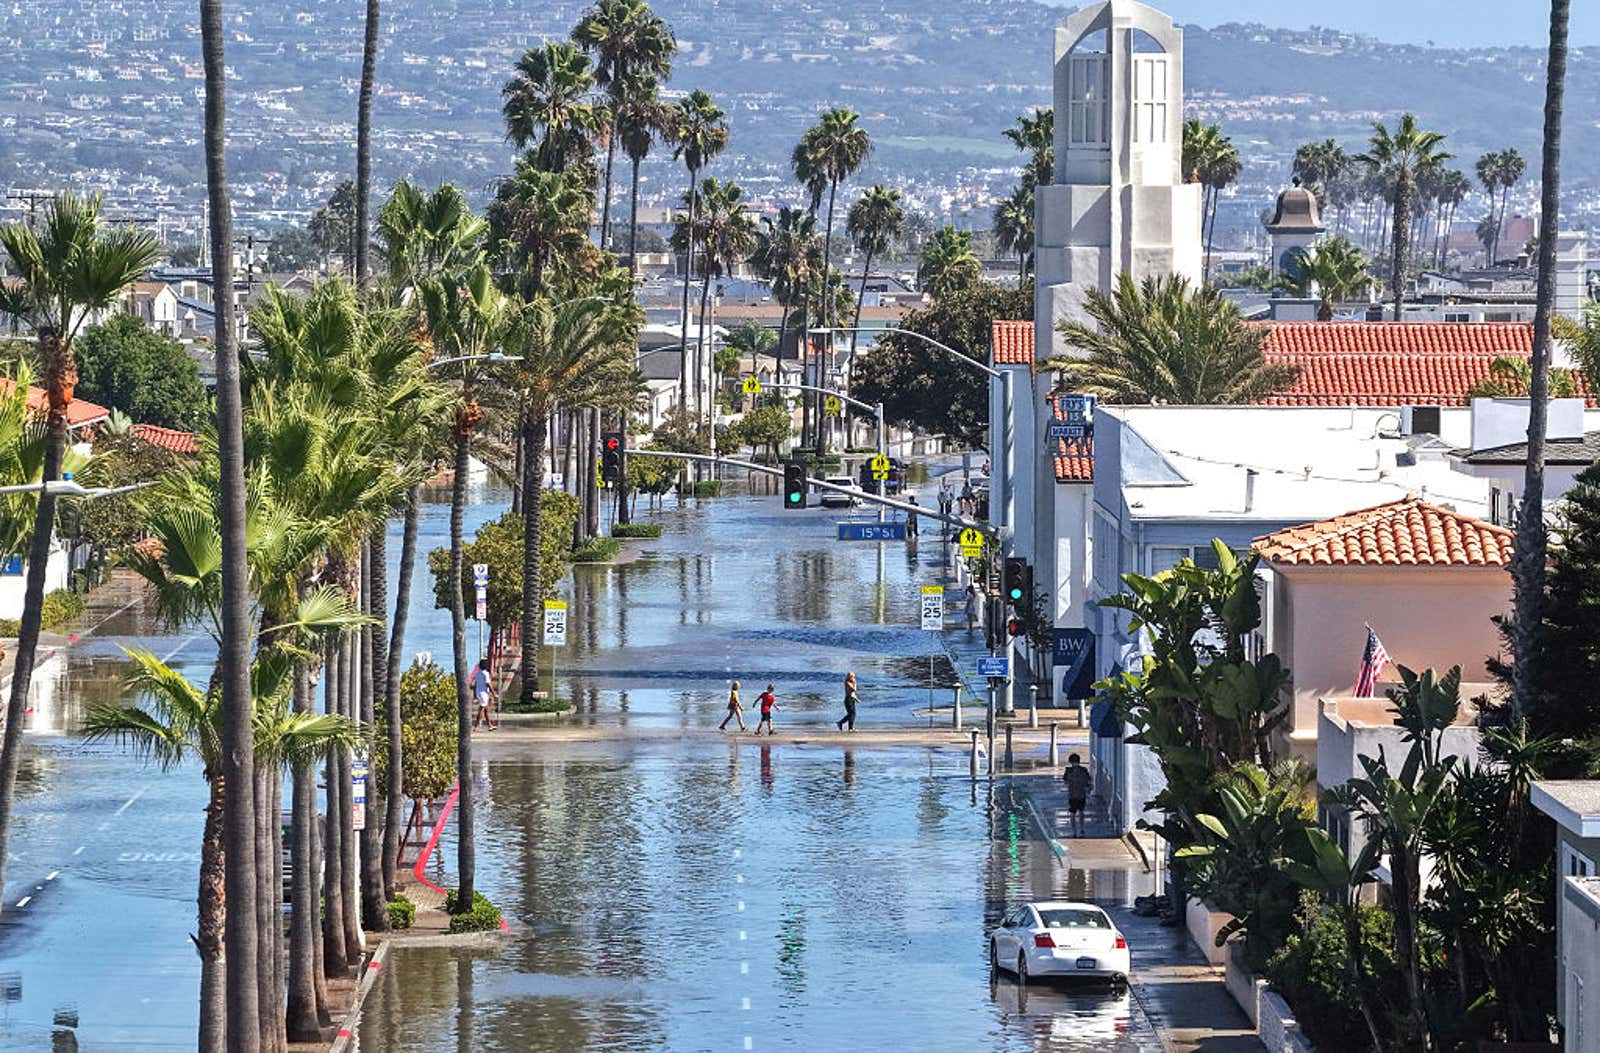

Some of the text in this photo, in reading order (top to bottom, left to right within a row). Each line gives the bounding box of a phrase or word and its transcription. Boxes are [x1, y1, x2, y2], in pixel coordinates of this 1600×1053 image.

[923, 608, 942, 618] 25
[546, 623, 564, 634] 25
[1060, 638, 1084, 650] BW
